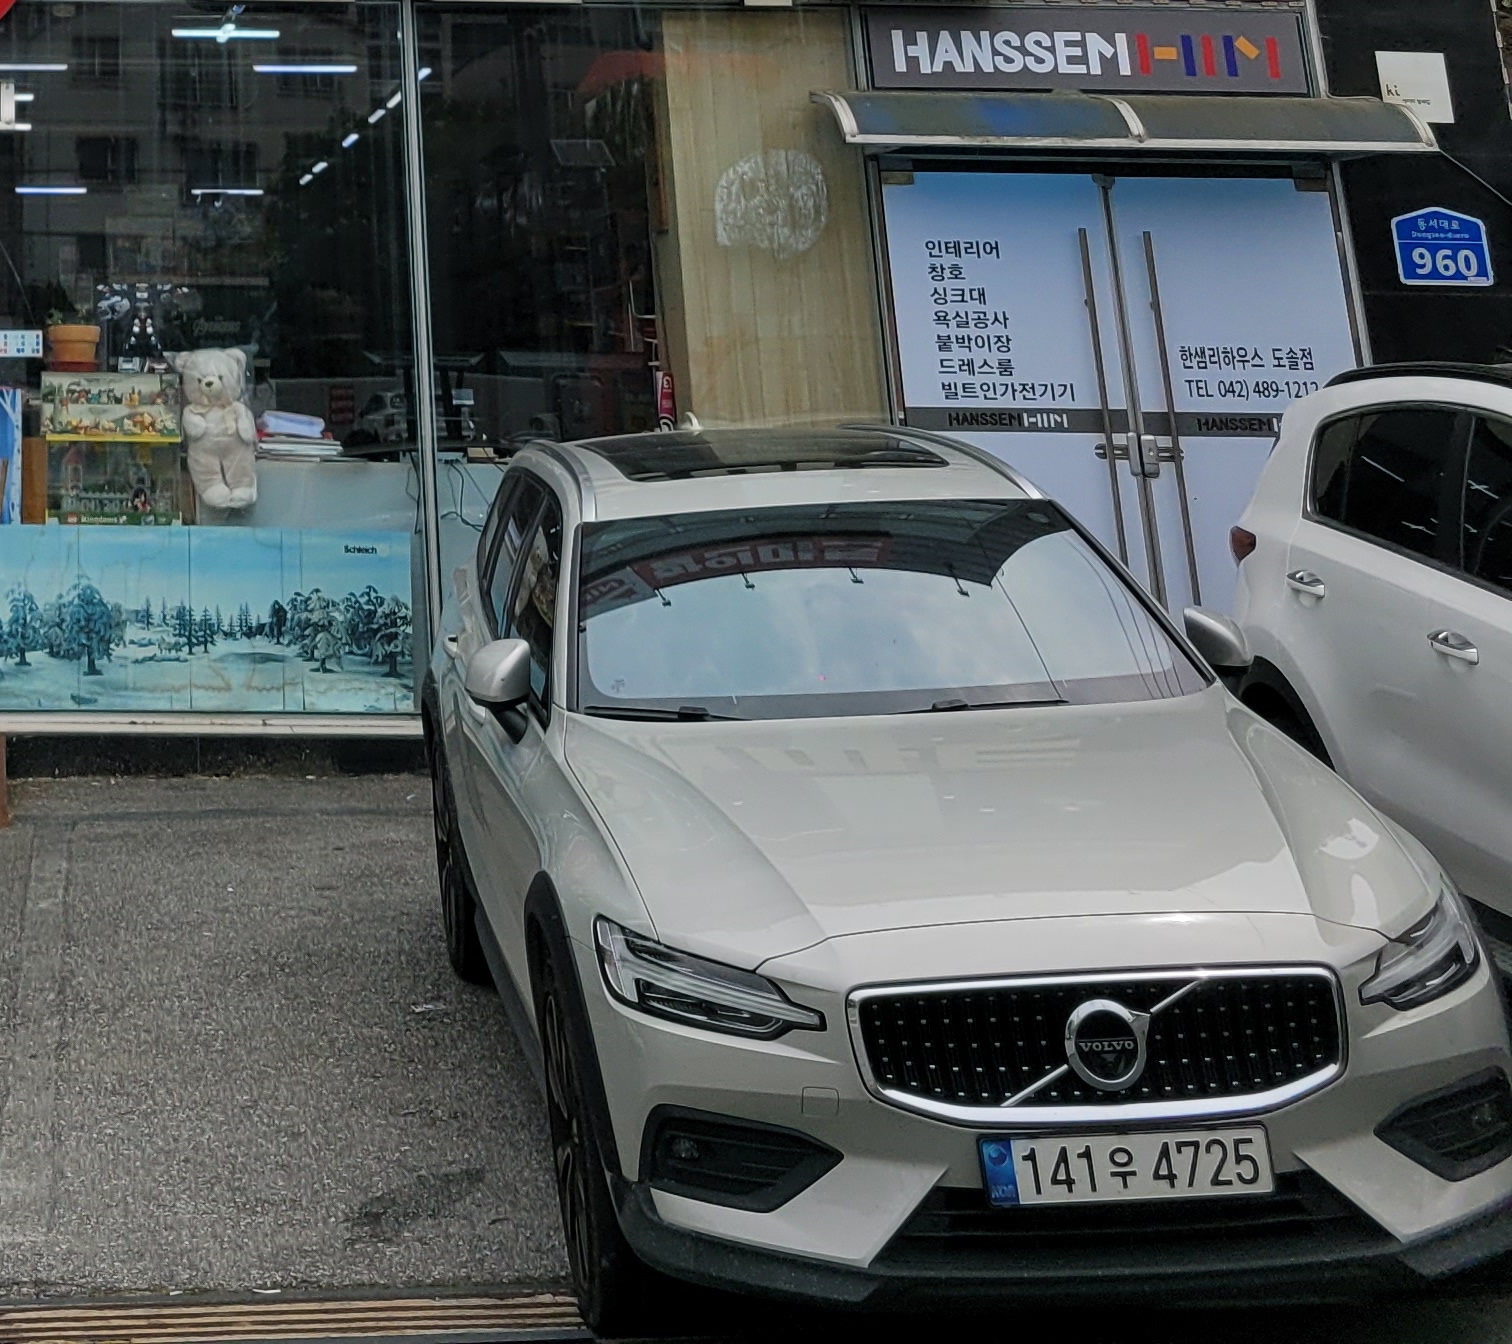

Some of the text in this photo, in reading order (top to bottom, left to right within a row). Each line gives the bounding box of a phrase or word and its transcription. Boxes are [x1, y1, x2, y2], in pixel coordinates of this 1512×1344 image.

[891, 29, 1132, 76] HANSSEM
[924, 240, 1001, 260] 인테리어
[1412, 247, 1478, 277] 960
[928, 263, 966, 282] 창호
[930, 286, 987, 306] 싱크대
[933, 310, 1010, 330] 욕실공사
[935, 334, 1012, 353] 붙박이장
[938, 358, 1016, 377] 드레스룸
[1179, 345, 1315, 371] 한샘리하우스 도솔점
[941, 382, 1076, 402] 빌트인가전기기
[1184, 379, 1214, 398] TEL
[1217, 379, 1250, 401] 042)
[948, 412, 1022, 427] HANSSEM
[1196, 417, 1273, 432] HANSSEM
[1078, 1040, 1135, 1052] VOLVO
[1021, 1137, 1260, 1196] 141우 4725
